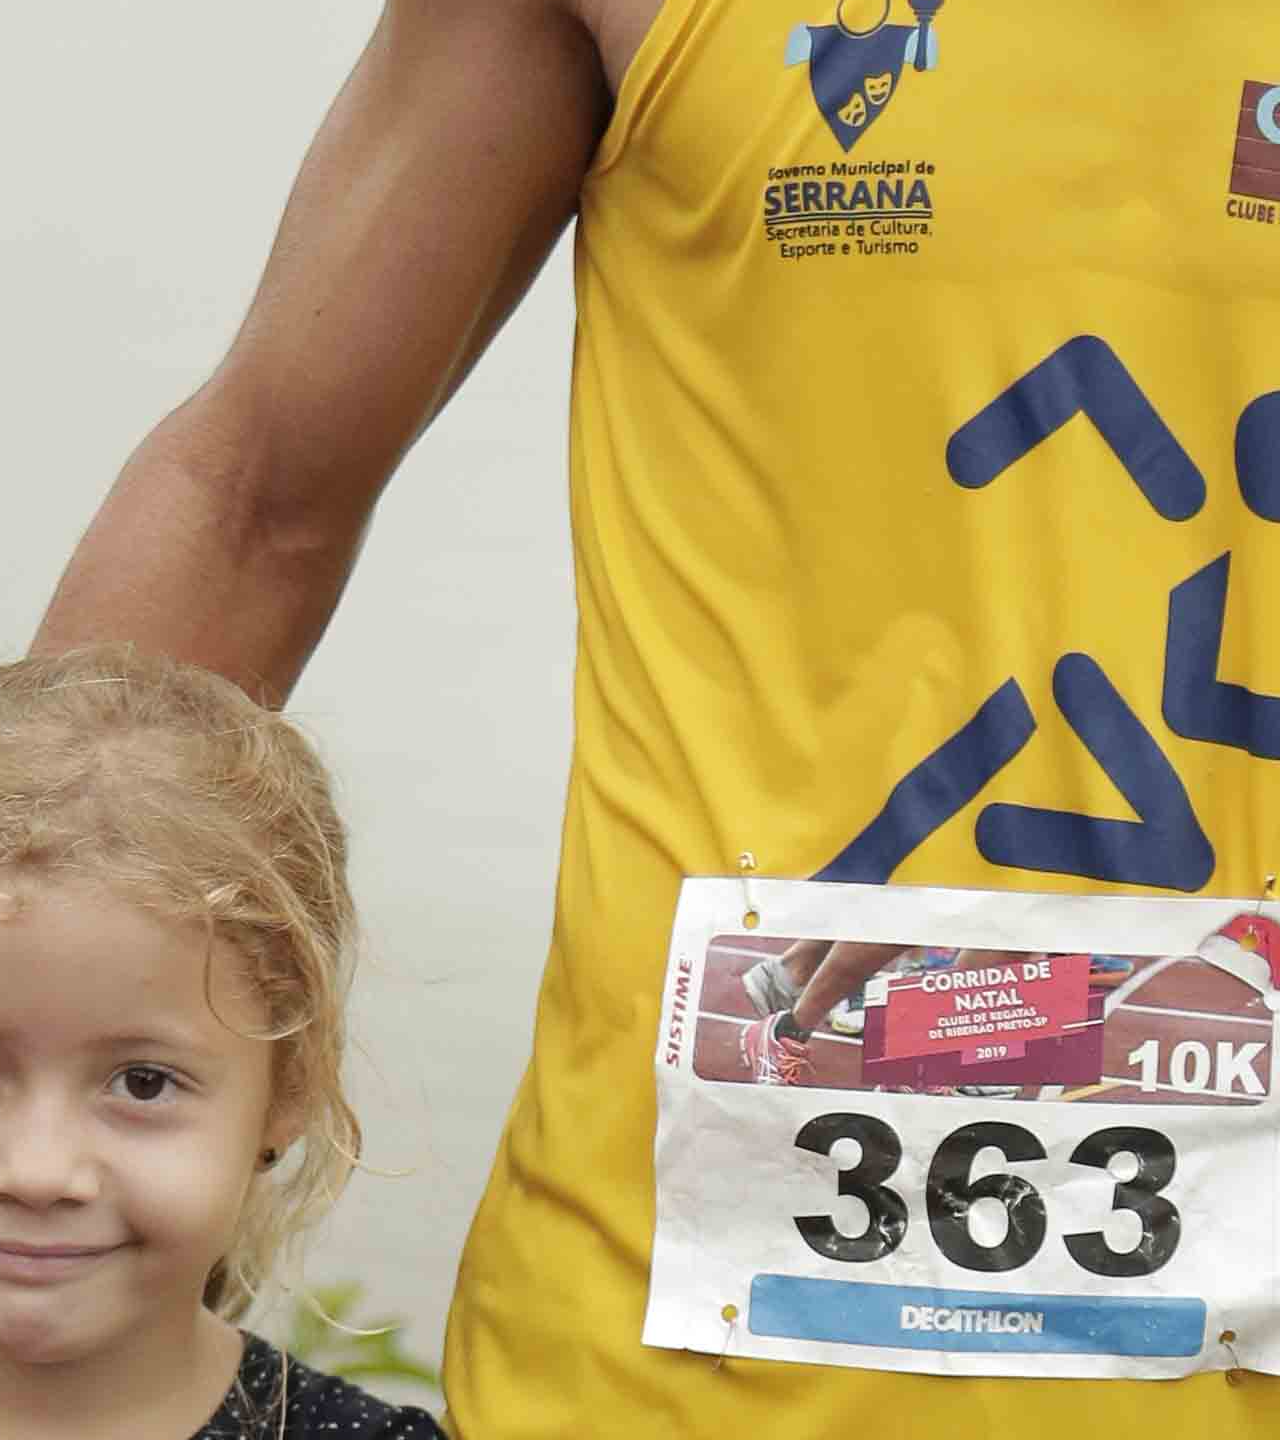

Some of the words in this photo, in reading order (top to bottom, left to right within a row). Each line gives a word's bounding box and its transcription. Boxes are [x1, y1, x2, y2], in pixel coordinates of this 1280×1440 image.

[832, 160, 910, 177] Municipal
[915, 161, 935, 175] de
[764, 179, 933, 216] SERRANA
[1226, 199, 1275, 225] CLUBE
[766, 222, 840, 241] Secretaria
[845, 222, 864, 237] de
[870, 220, 933, 237] Cultura,
[780, 242, 835, 260] Esporte
[841, 244, 850, 255] e
[857, 239, 919, 255] Turismo
[922, 967, 1018, 993] CORRIDA
[1023, 961, 1052, 981] DE
[954, 988, 1024, 1012] NATAL
[665, 958, 693, 1069] SISTIME
[938, 1014, 971, 1027] CLUBE
[973, 1012, 988, 1024] DE
[990, 1007, 1037, 1022] REGATAS
[929, 1030, 944, 1040] DE
[975, 1045, 1008, 1059] 2019
[1128, 1039, 1267, 1096] 10K
[793, 1112, 1181, 1278] 363
[900, 1304, 1043, 1334] DECATHLON
